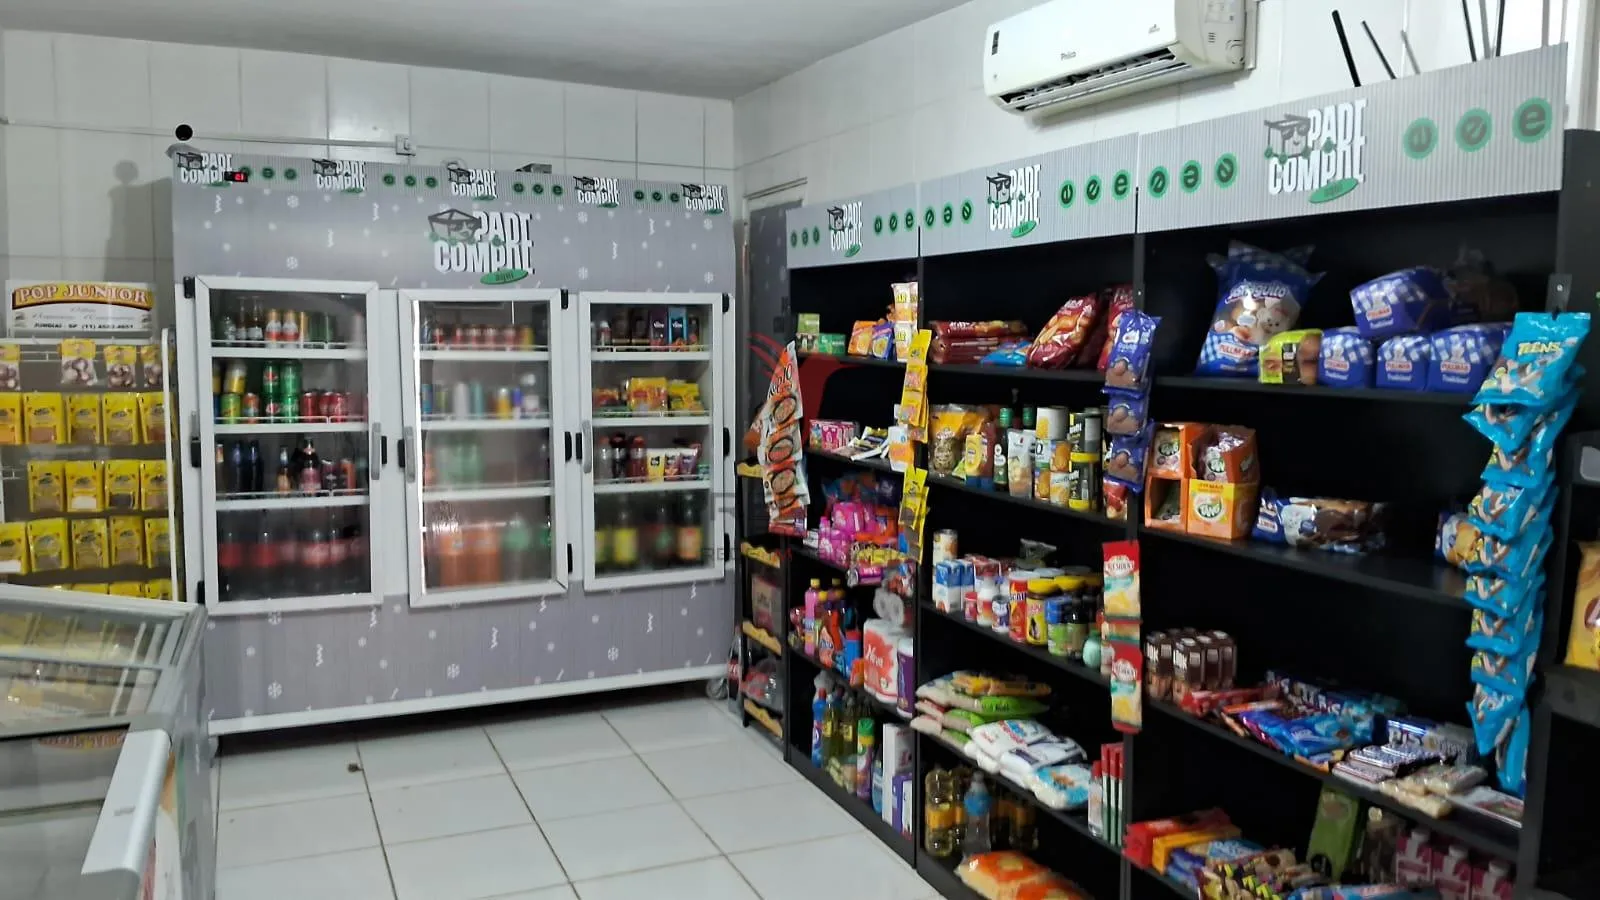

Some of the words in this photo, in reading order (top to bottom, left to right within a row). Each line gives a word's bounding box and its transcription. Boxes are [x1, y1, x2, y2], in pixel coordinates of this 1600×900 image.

[20, 285, 58, 302] POP
[64, 284, 147, 302] JUNIOR
[1518, 341, 1560, 356] TEENS
